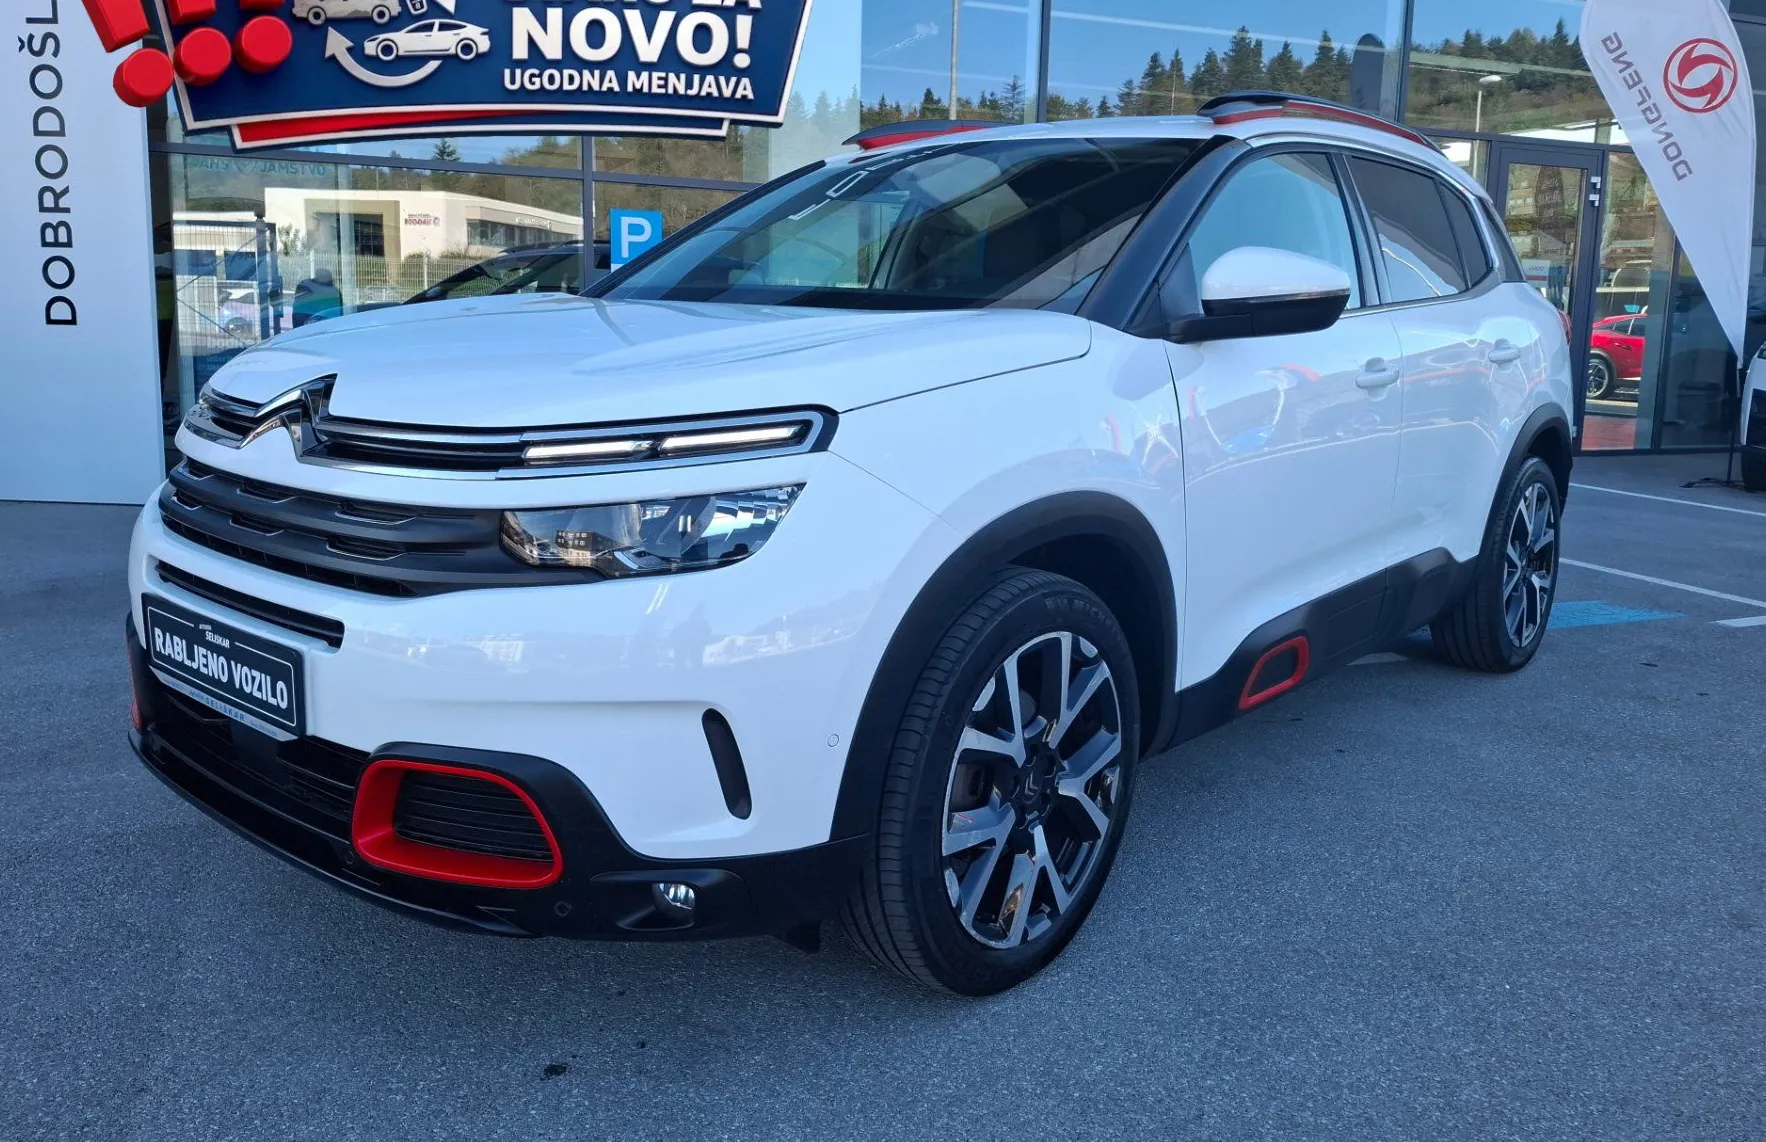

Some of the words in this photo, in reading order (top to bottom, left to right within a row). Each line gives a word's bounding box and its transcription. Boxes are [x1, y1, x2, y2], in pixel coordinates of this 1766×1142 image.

[17, 0, 78, 326] DOBRODOŠL
[259, 161, 326, 176] JAMSTVO
[620, 216, 652, 258] P
[154, 627, 229, 683] RABLJENO
[230, 660, 288, 709] VOZILO
